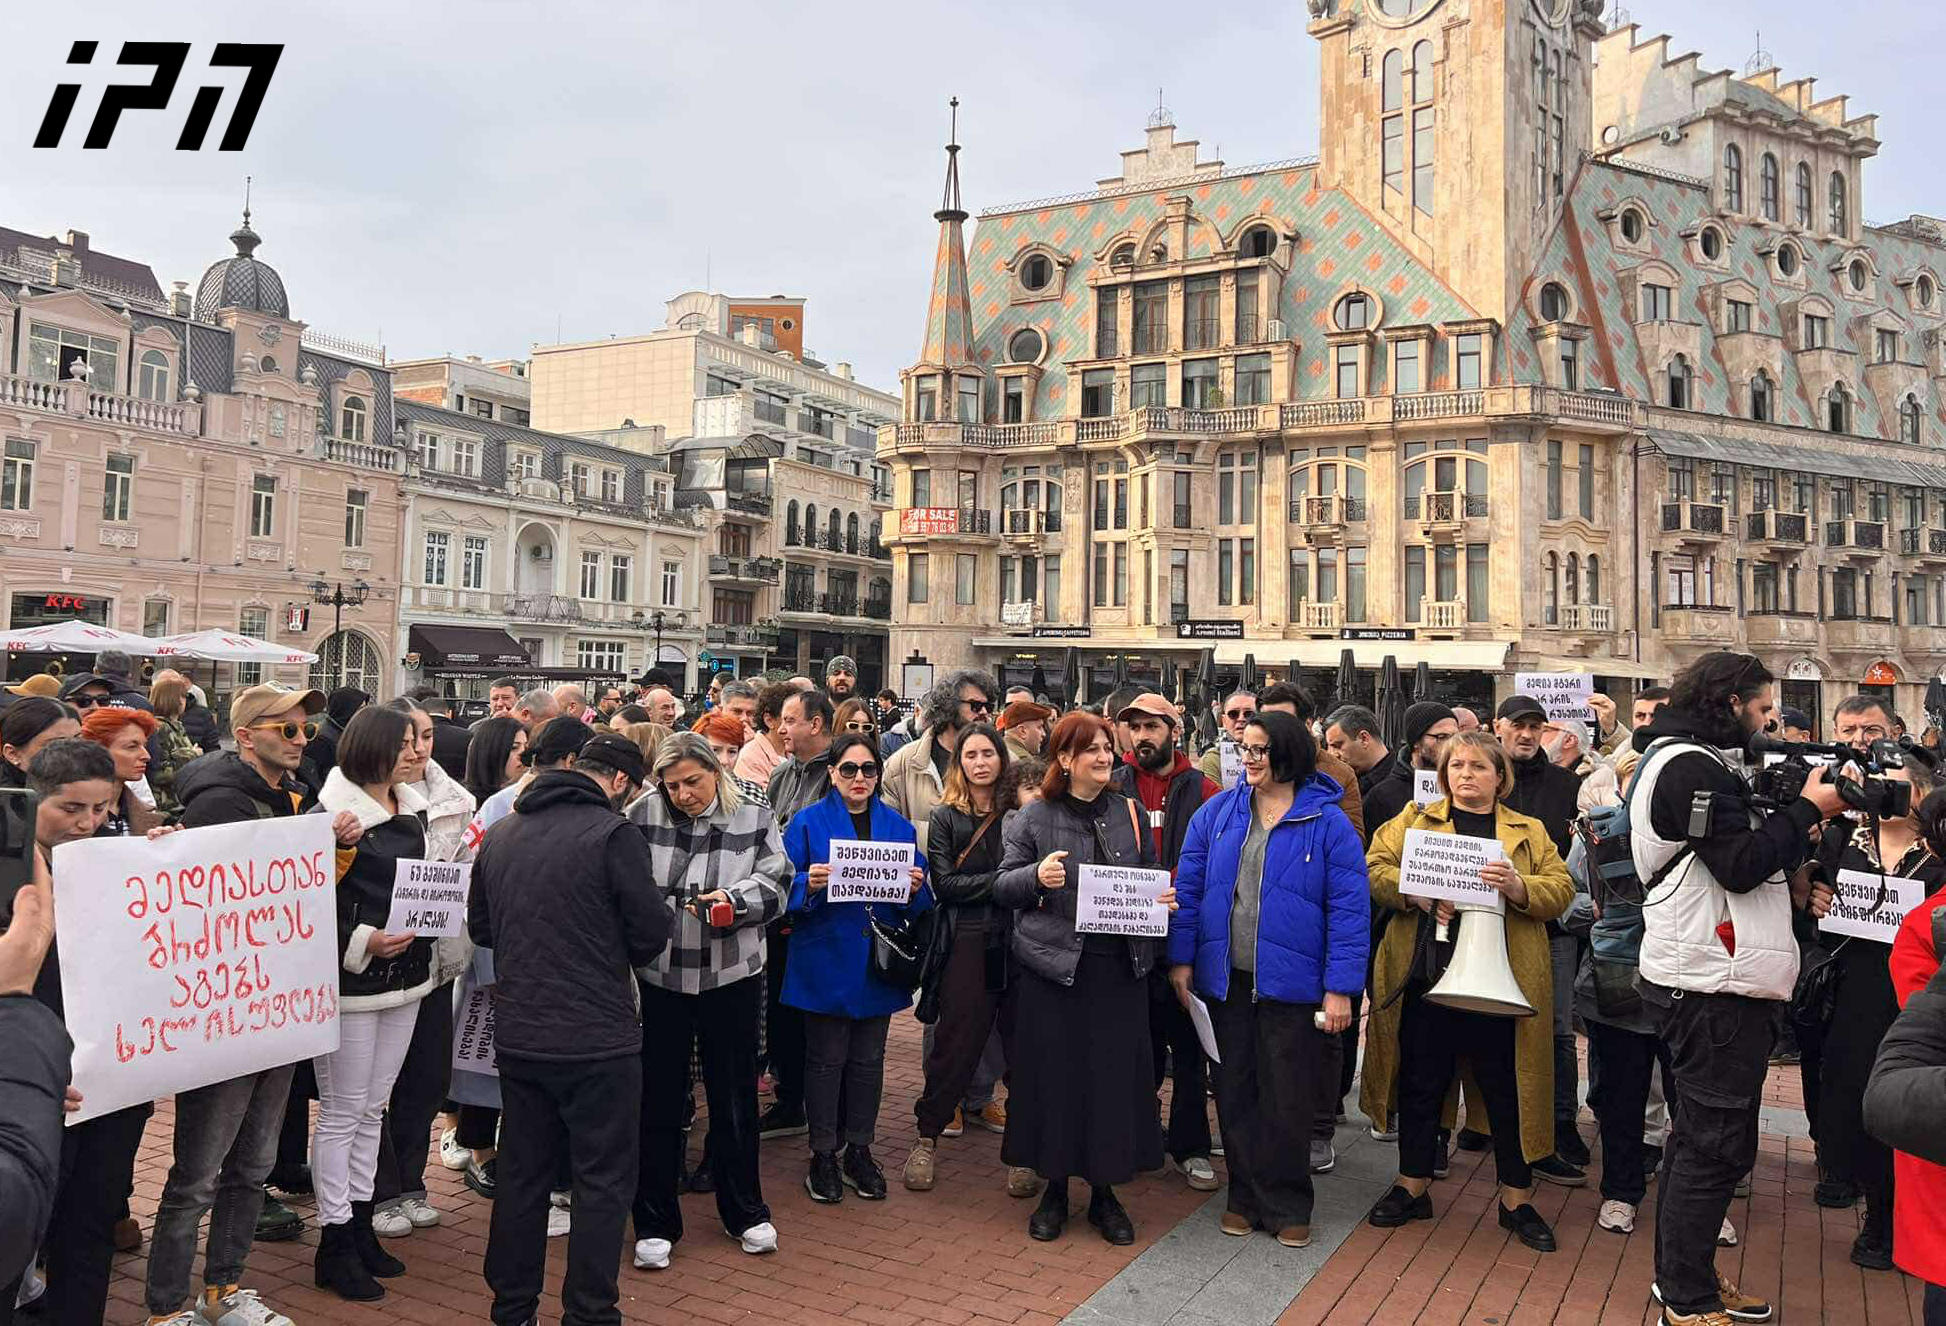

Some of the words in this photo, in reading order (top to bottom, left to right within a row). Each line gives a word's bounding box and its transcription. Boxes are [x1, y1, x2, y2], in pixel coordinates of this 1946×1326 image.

[908, 509, 926, 520] FOR
[930, 509, 954, 520] SALE
[45, 594, 86, 609] KFC
[8, 641, 29, 650] KFC
[157, 646, 177, 655] KFC
[285, 654, 304, 663] KFC
[1526, 679, 1551, 688] მედია
[1554, 679, 1581, 688] მტერი
[1549, 708, 1590, 718] რუსეთია!
[1424, 836, 1453, 847] მიეცით
[1454, 840, 1483, 852] მედიის
[837, 847, 908, 862] შეწყვიტეთ
[410, 865, 421, 881] ნუ
[841, 867, 898, 880] მედიაზე
[1408, 860, 1452, 875] უსაფრთხო
[1453, 866, 1482, 878] გარემ
[125, 852, 327, 919] მედიასთან
[1406, 873, 1445, 887] მუშაობის
[832, 884, 906, 899] თავდასხმა!
[1113, 883, 1123, 893] და
[1839, 883, 1899, 904] შეწყვიეთ
[1139, 912, 1148, 920] და
[141, 900, 314, 969] ბრძოლას
[170, 954, 270, 1010] აგებს
[115, 982, 338, 1063] ხელისუფლება
[458, 991, 484, 1060] წახალისება!
